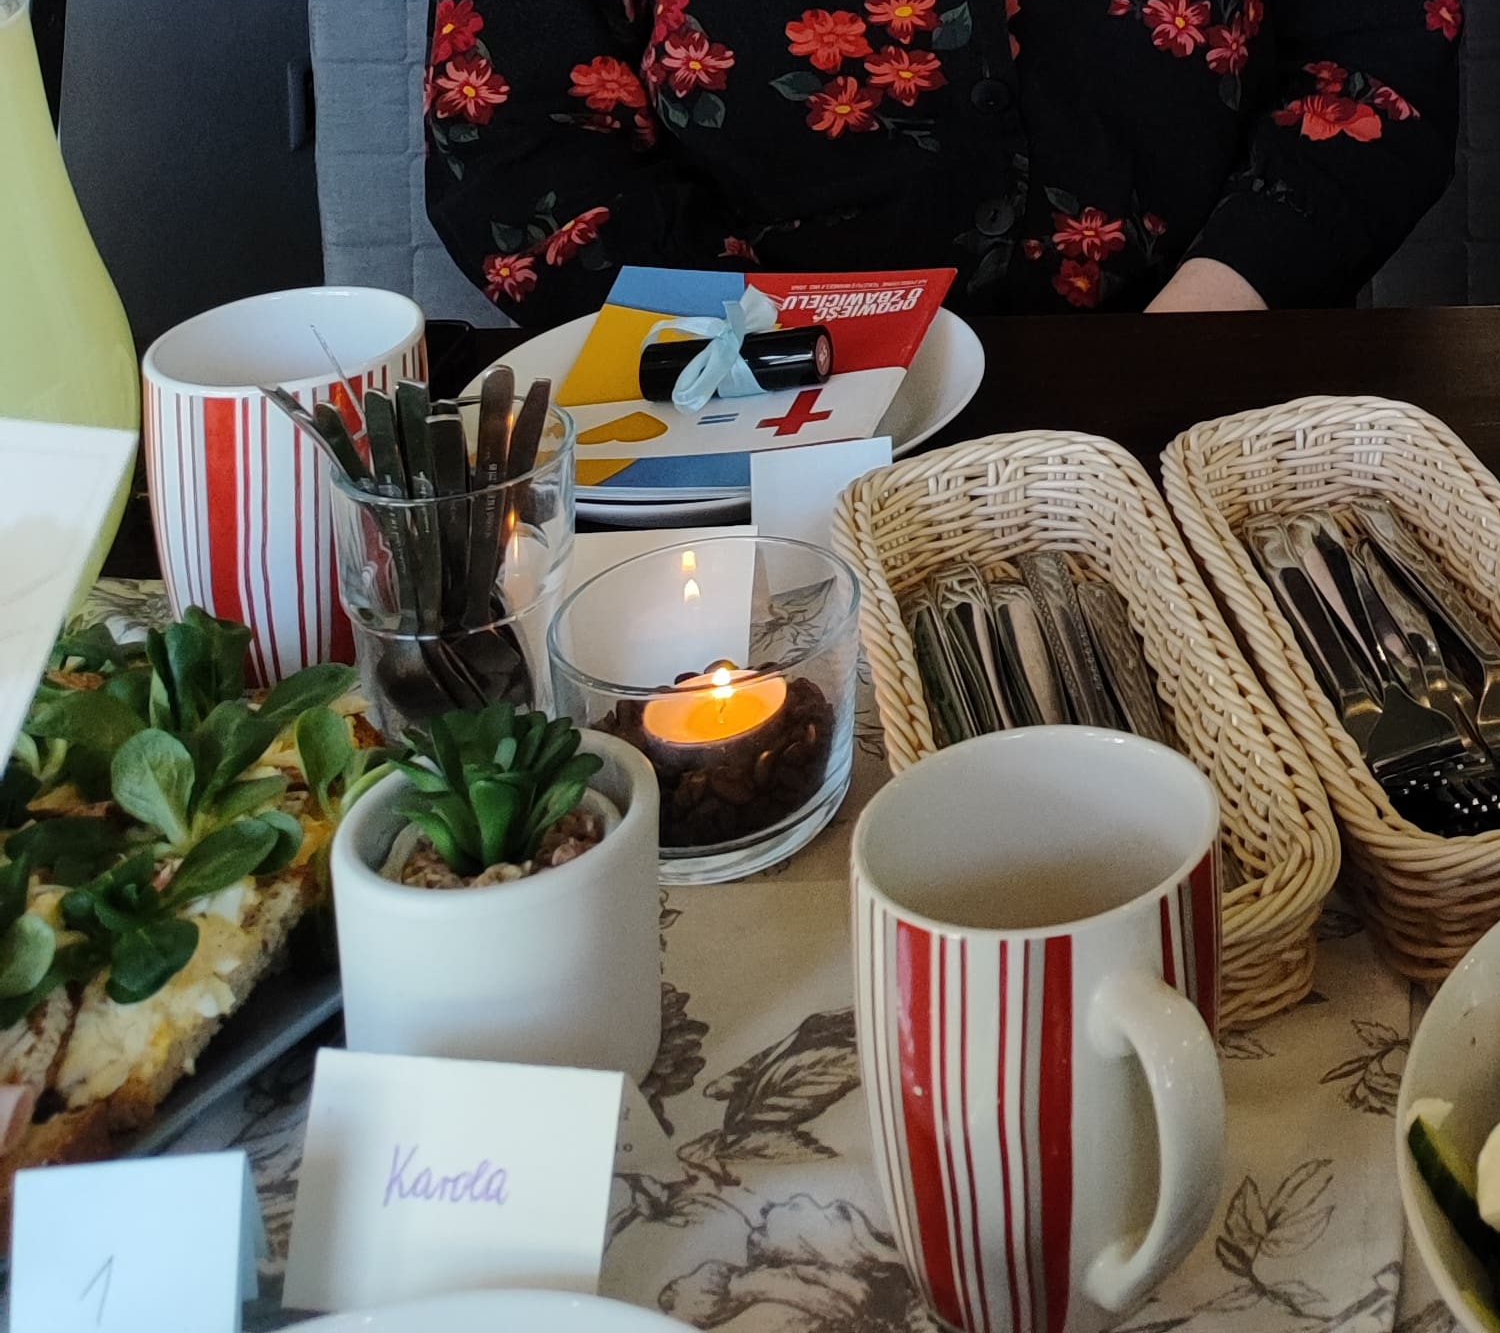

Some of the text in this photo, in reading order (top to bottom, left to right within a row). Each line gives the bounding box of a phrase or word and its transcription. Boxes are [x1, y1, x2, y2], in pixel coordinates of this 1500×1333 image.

[781, 289, 905, 311] ZBAWICIELU
[811, 296, 919, 324] OPOWIEŚĆ
[382, 1142, 510, 1208] Karola
[79, 1254, 115, 1327] 1
